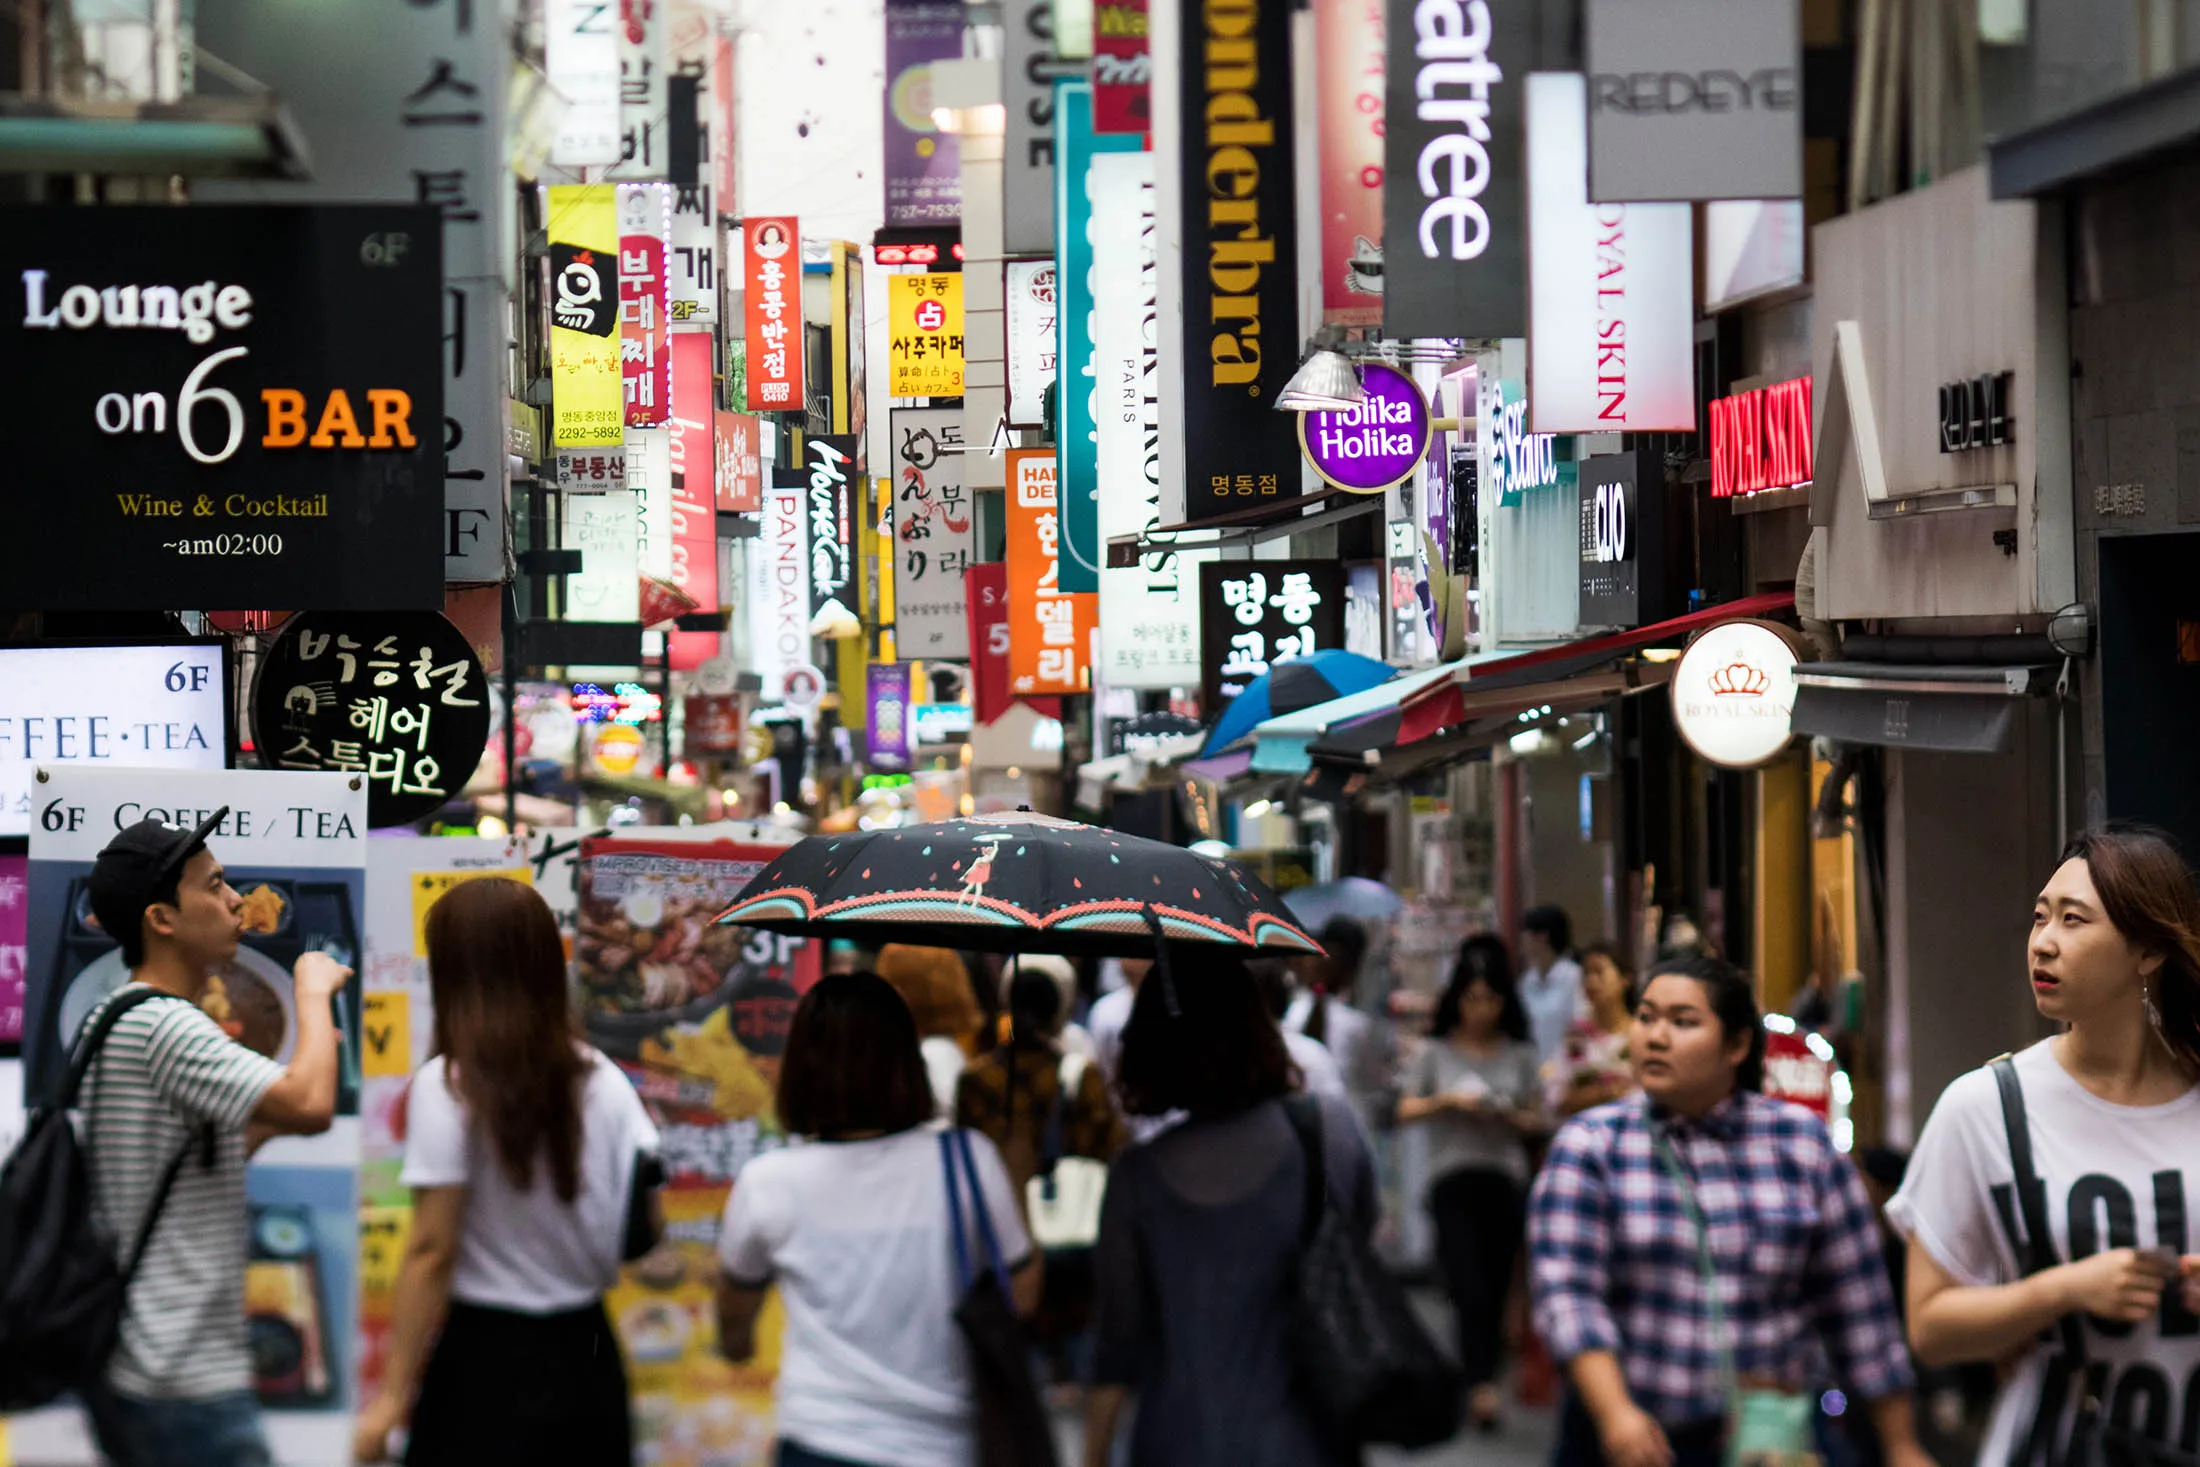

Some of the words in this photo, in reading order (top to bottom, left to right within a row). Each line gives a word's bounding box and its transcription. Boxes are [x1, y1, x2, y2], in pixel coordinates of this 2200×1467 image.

[1590, 67, 1797, 116] REDEYE
[360, 232, 412, 266] 6F
[22, 269, 253, 344] Lounge
[908, 277, 949, 297] 명동
[756, 260, 789, 379] 홍콩반점
[1122, 359, 1137, 423] PARIS
[1597, 318, 1627, 423] SKIN
[261, 388, 417, 449] BAR
[762, 392, 789, 402] 0410
[559, 426, 621, 440] 2292-5892
[1320, 429, 1414, 460] Holika
[1709, 388, 1768, 497] ROYAL
[1765, 375, 1813, 488] SKIN
[571, 455, 625, 481] 부동산
[1210, 473, 1278, 497] 명동점
[117, 494, 184, 517] Wine
[192, 494, 215, 517] &
[224, 493, 329, 518] Cocktail
[1026, 485, 1057, 499] DE
[162, 532, 283, 556] ~am02:00
[776, 495, 799, 669] PANDAKO
[1220, 572, 1322, 625] 명동
[164, 660, 210, 693] 6F
[299, 629, 480, 707] 박승철
[348, 696, 431, 753] 헤어
[1685, 703, 1744, 718] ROYAL
[283, 735, 448, 796] 스투디오
[41, 797, 86, 833] 6F
[287, 806, 358, 840] TEA
